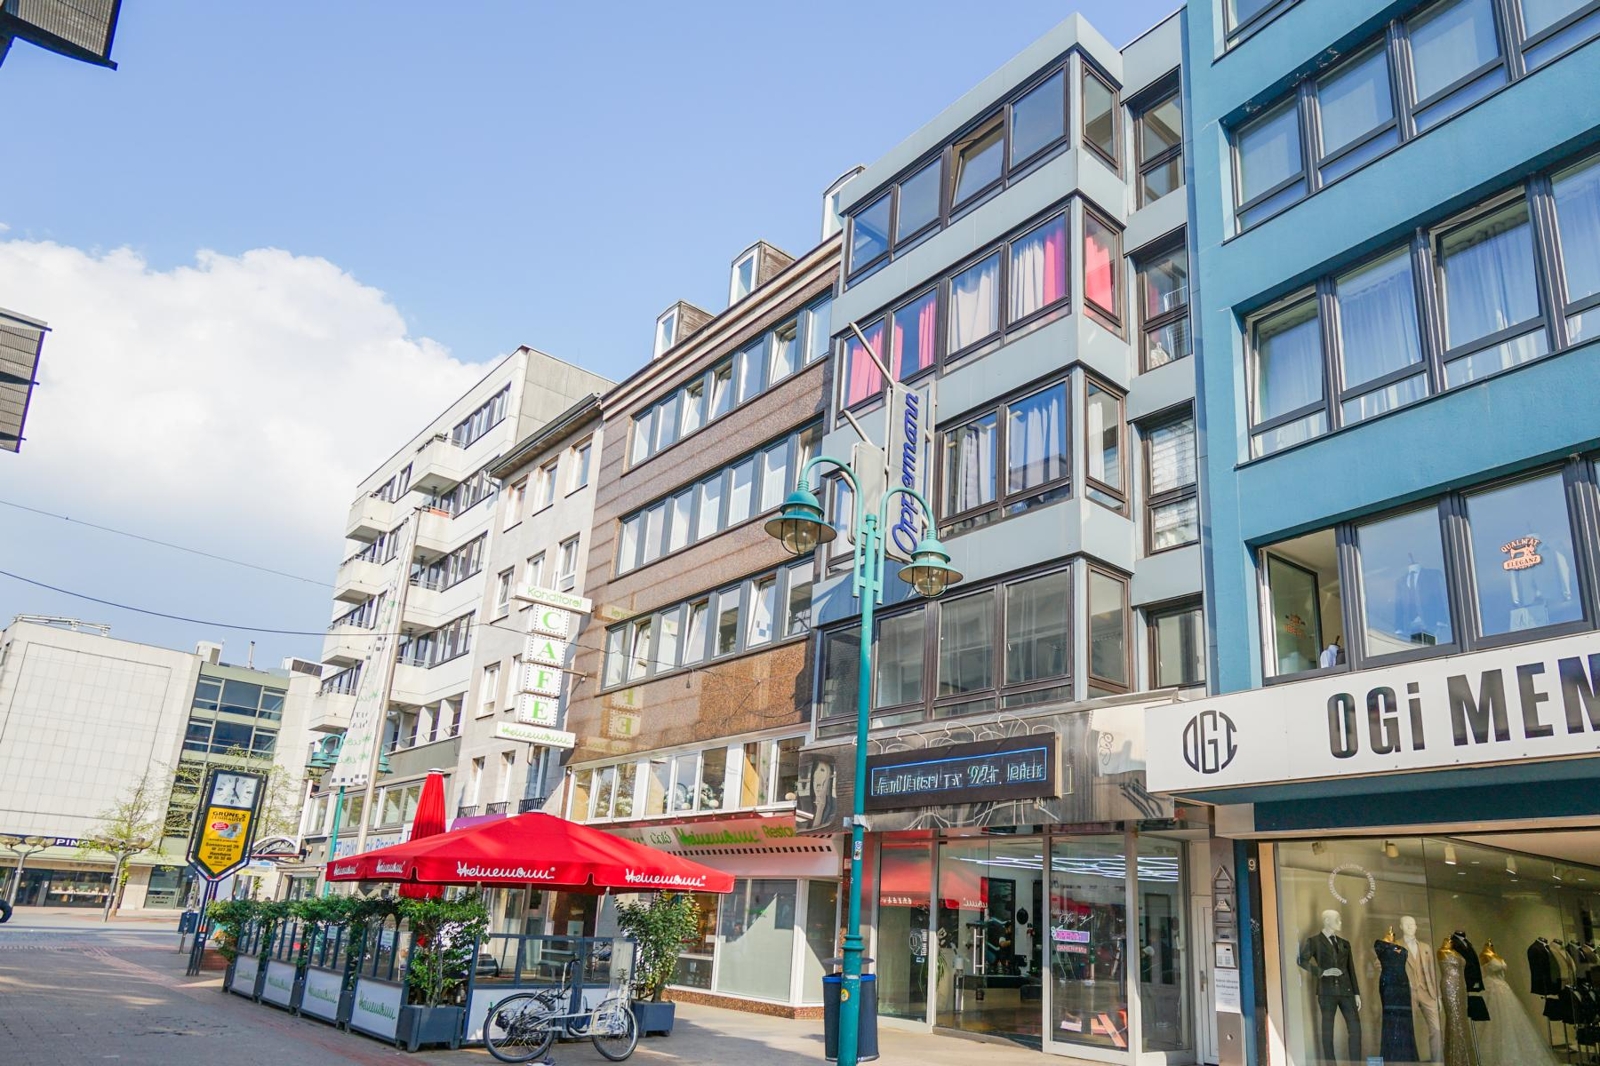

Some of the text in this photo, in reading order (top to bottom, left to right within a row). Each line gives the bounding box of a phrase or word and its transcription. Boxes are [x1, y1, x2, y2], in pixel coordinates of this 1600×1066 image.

[891, 392, 920, 556] Oppermann
[527, 586, 582, 609] Konditorei
[1447, 653, 1600, 747] MEN
[1248, 858, 1256, 871] 9
